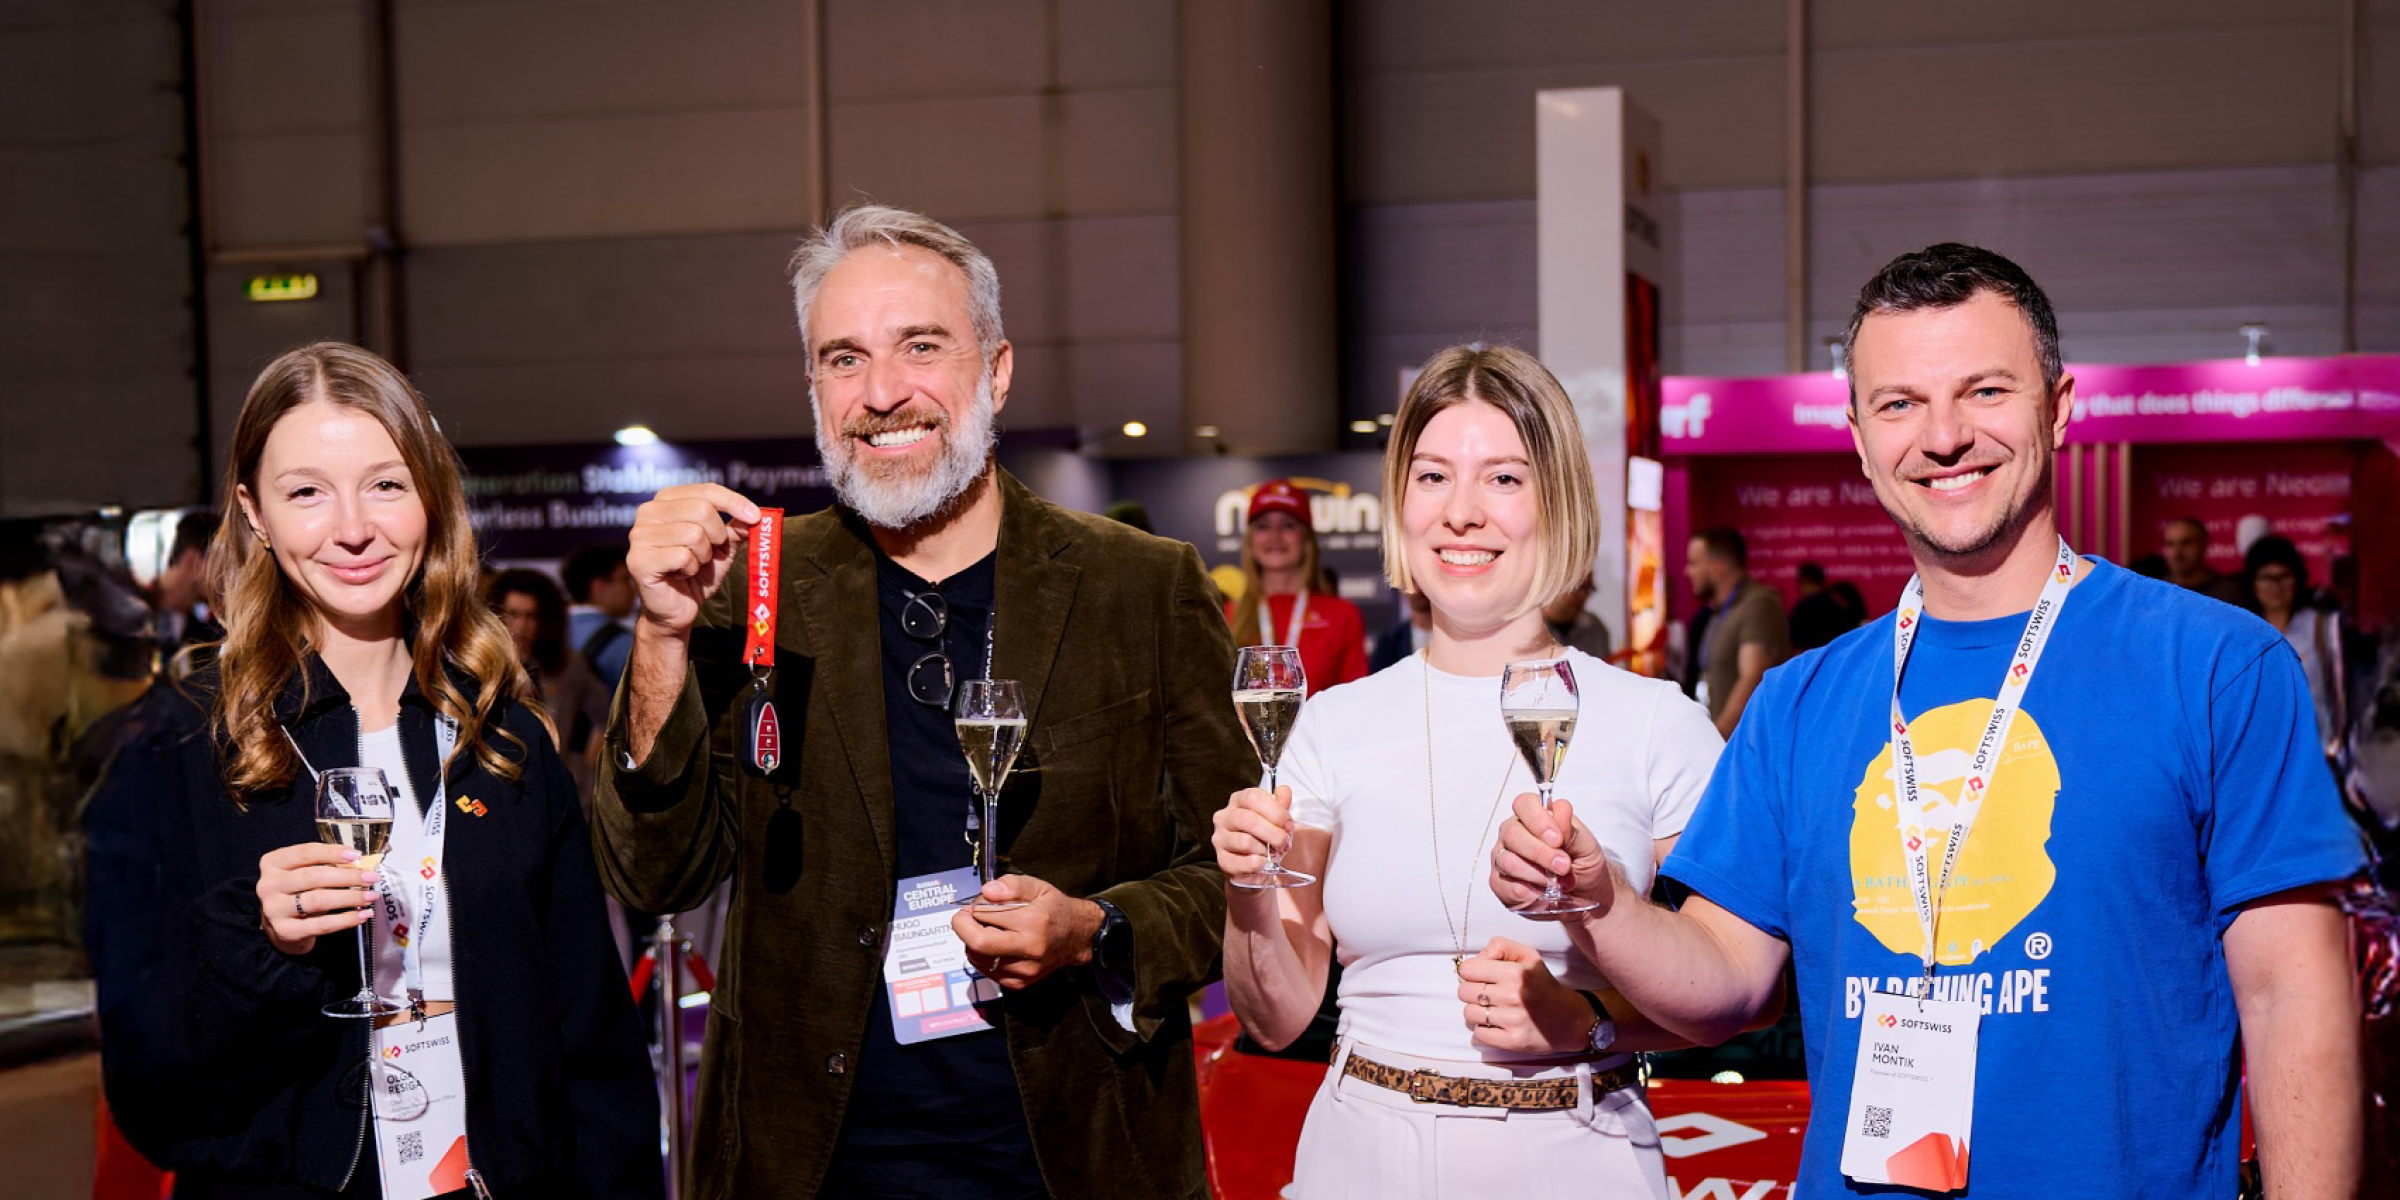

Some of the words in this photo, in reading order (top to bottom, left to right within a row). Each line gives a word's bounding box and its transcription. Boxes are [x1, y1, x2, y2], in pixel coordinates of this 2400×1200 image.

[2089, 393, 2135, 417] that
[2138, 391, 2189, 415] does
[2191, 388, 2260, 418] things
[1839, 480, 1878, 507] Ne
[759, 516, 773, 598] SOFTSWISS
[2018, 598, 2051, 659] SOFTSWISS
[1973, 708, 2005, 770] SOFTSWISS
[2013, 739, 2041, 752] BAPE
[1900, 739, 1918, 802] SOFTSWISS
[903, 883, 958, 903] CENTRAL
[908, 893, 957, 912] EUROPE
[894, 919, 920, 931] HUGO
[1997, 968, 2051, 1015] APE
[1900, 1018, 1953, 1034] SOFTSWISS
[405, 1035, 450, 1054] SOFTSWISS
[1873, 1041, 1900, 1054] IVAN
[1872, 1054, 1915, 1068] MONTIK
